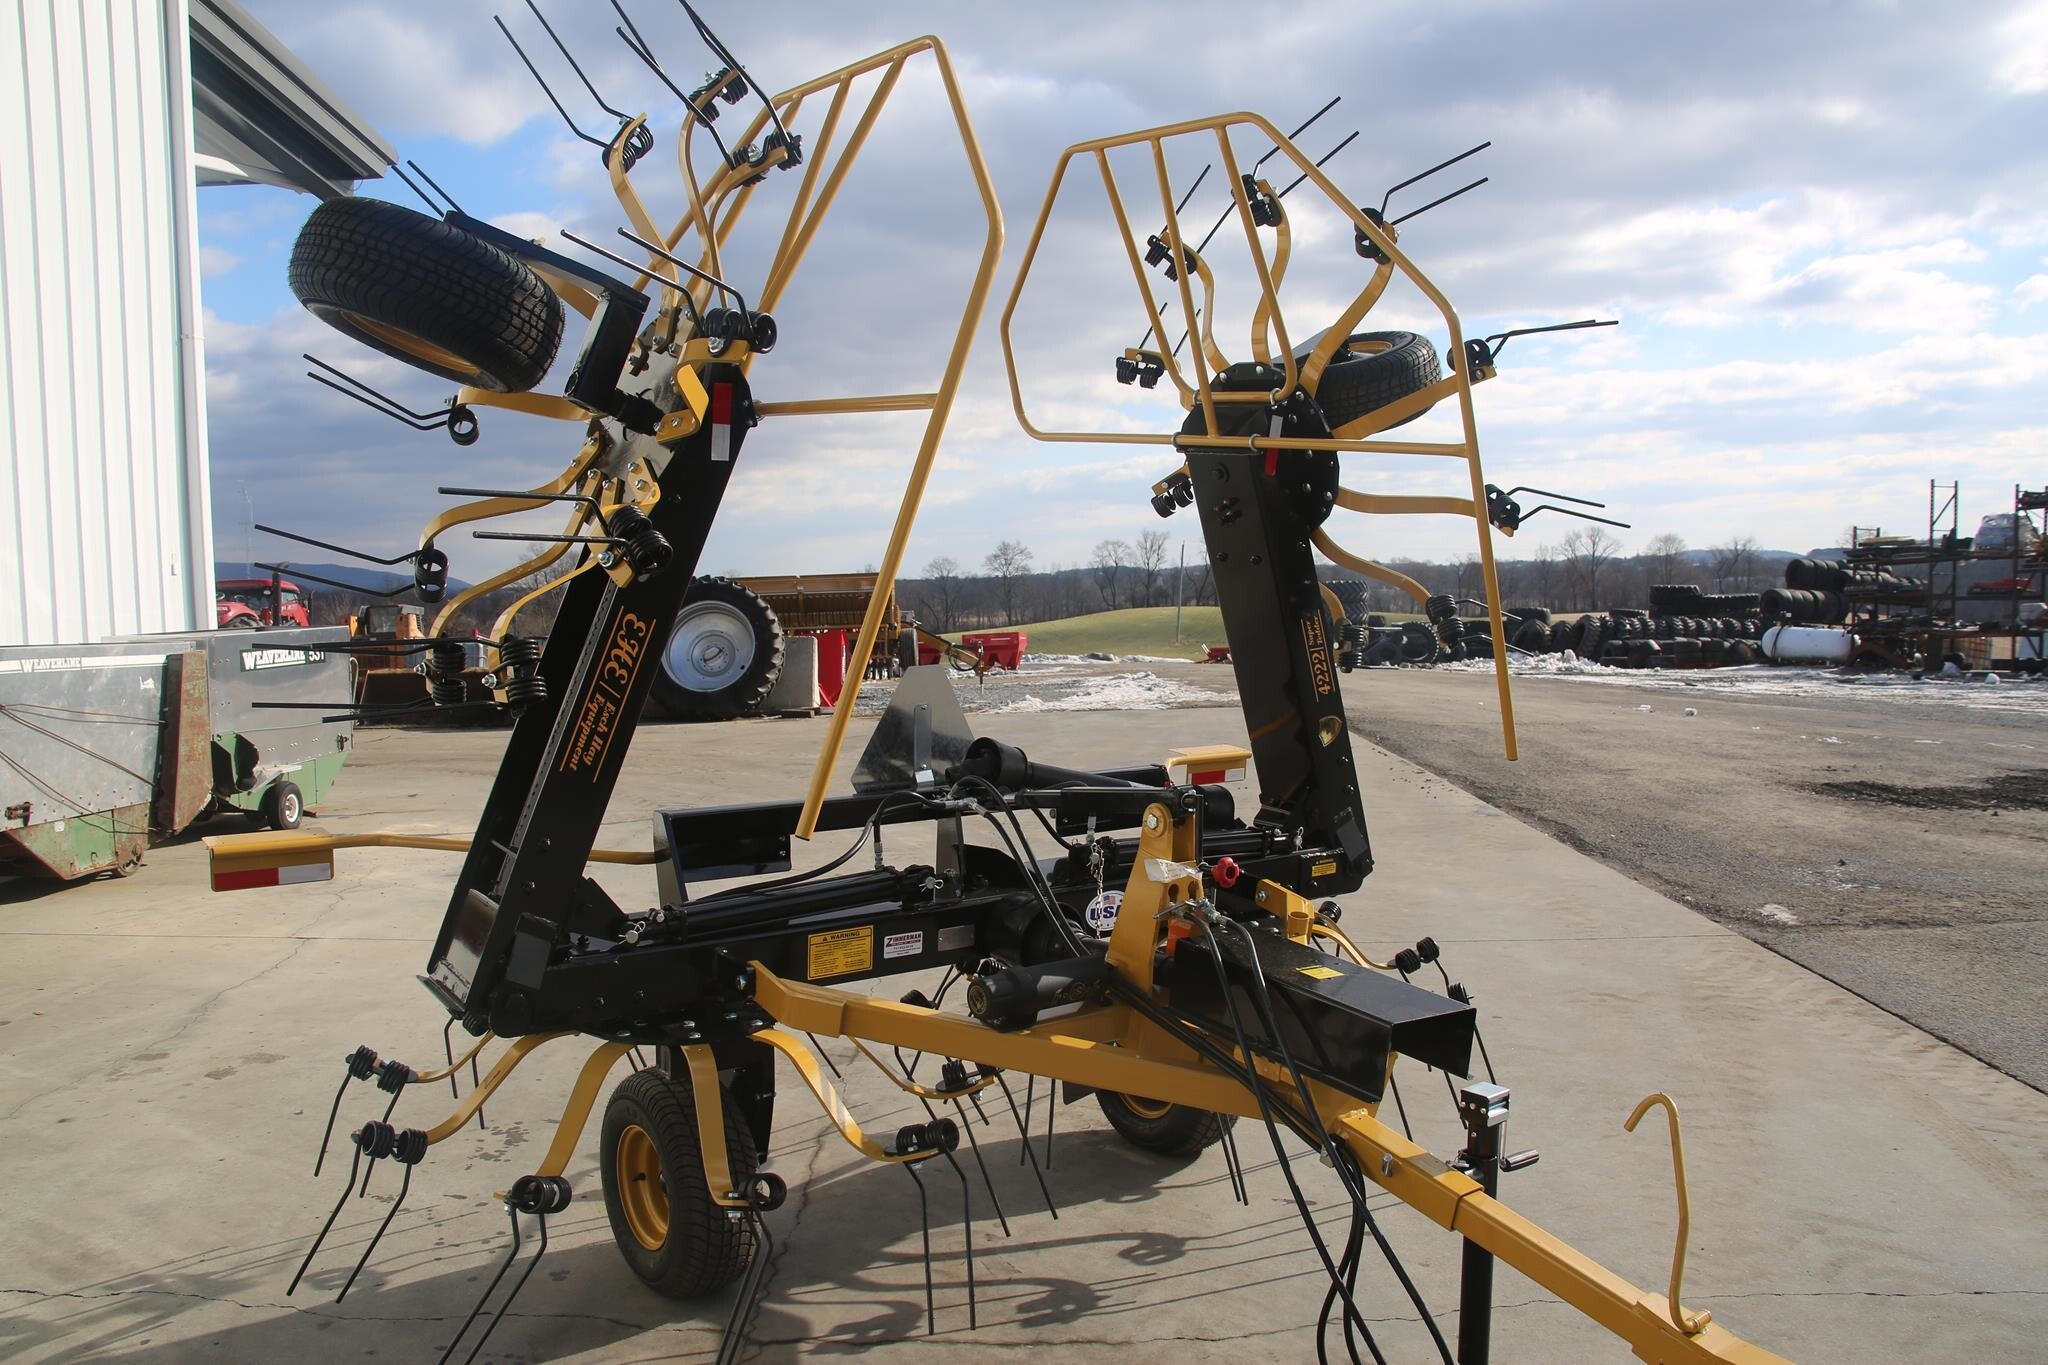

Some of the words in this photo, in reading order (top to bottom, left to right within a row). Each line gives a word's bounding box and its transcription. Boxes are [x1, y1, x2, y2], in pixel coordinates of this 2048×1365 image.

[1306, 620, 1315, 646] Super
[1313, 615, 1323, 646] Tedder
[242, 649, 306, 670] WEAVERLINE
[604, 612, 646, 685] EHE
[21, 657, 81, 673] WEAVERLINE
[1311, 650, 1331, 695] 4222
[569, 692, 606, 772] Equipment
[598, 701, 616, 734] Esch
[583, 734, 604, 766] Hay
[830, 930, 861, 941] WARNING
[885, 932, 922, 948] ZIMMERMAN
